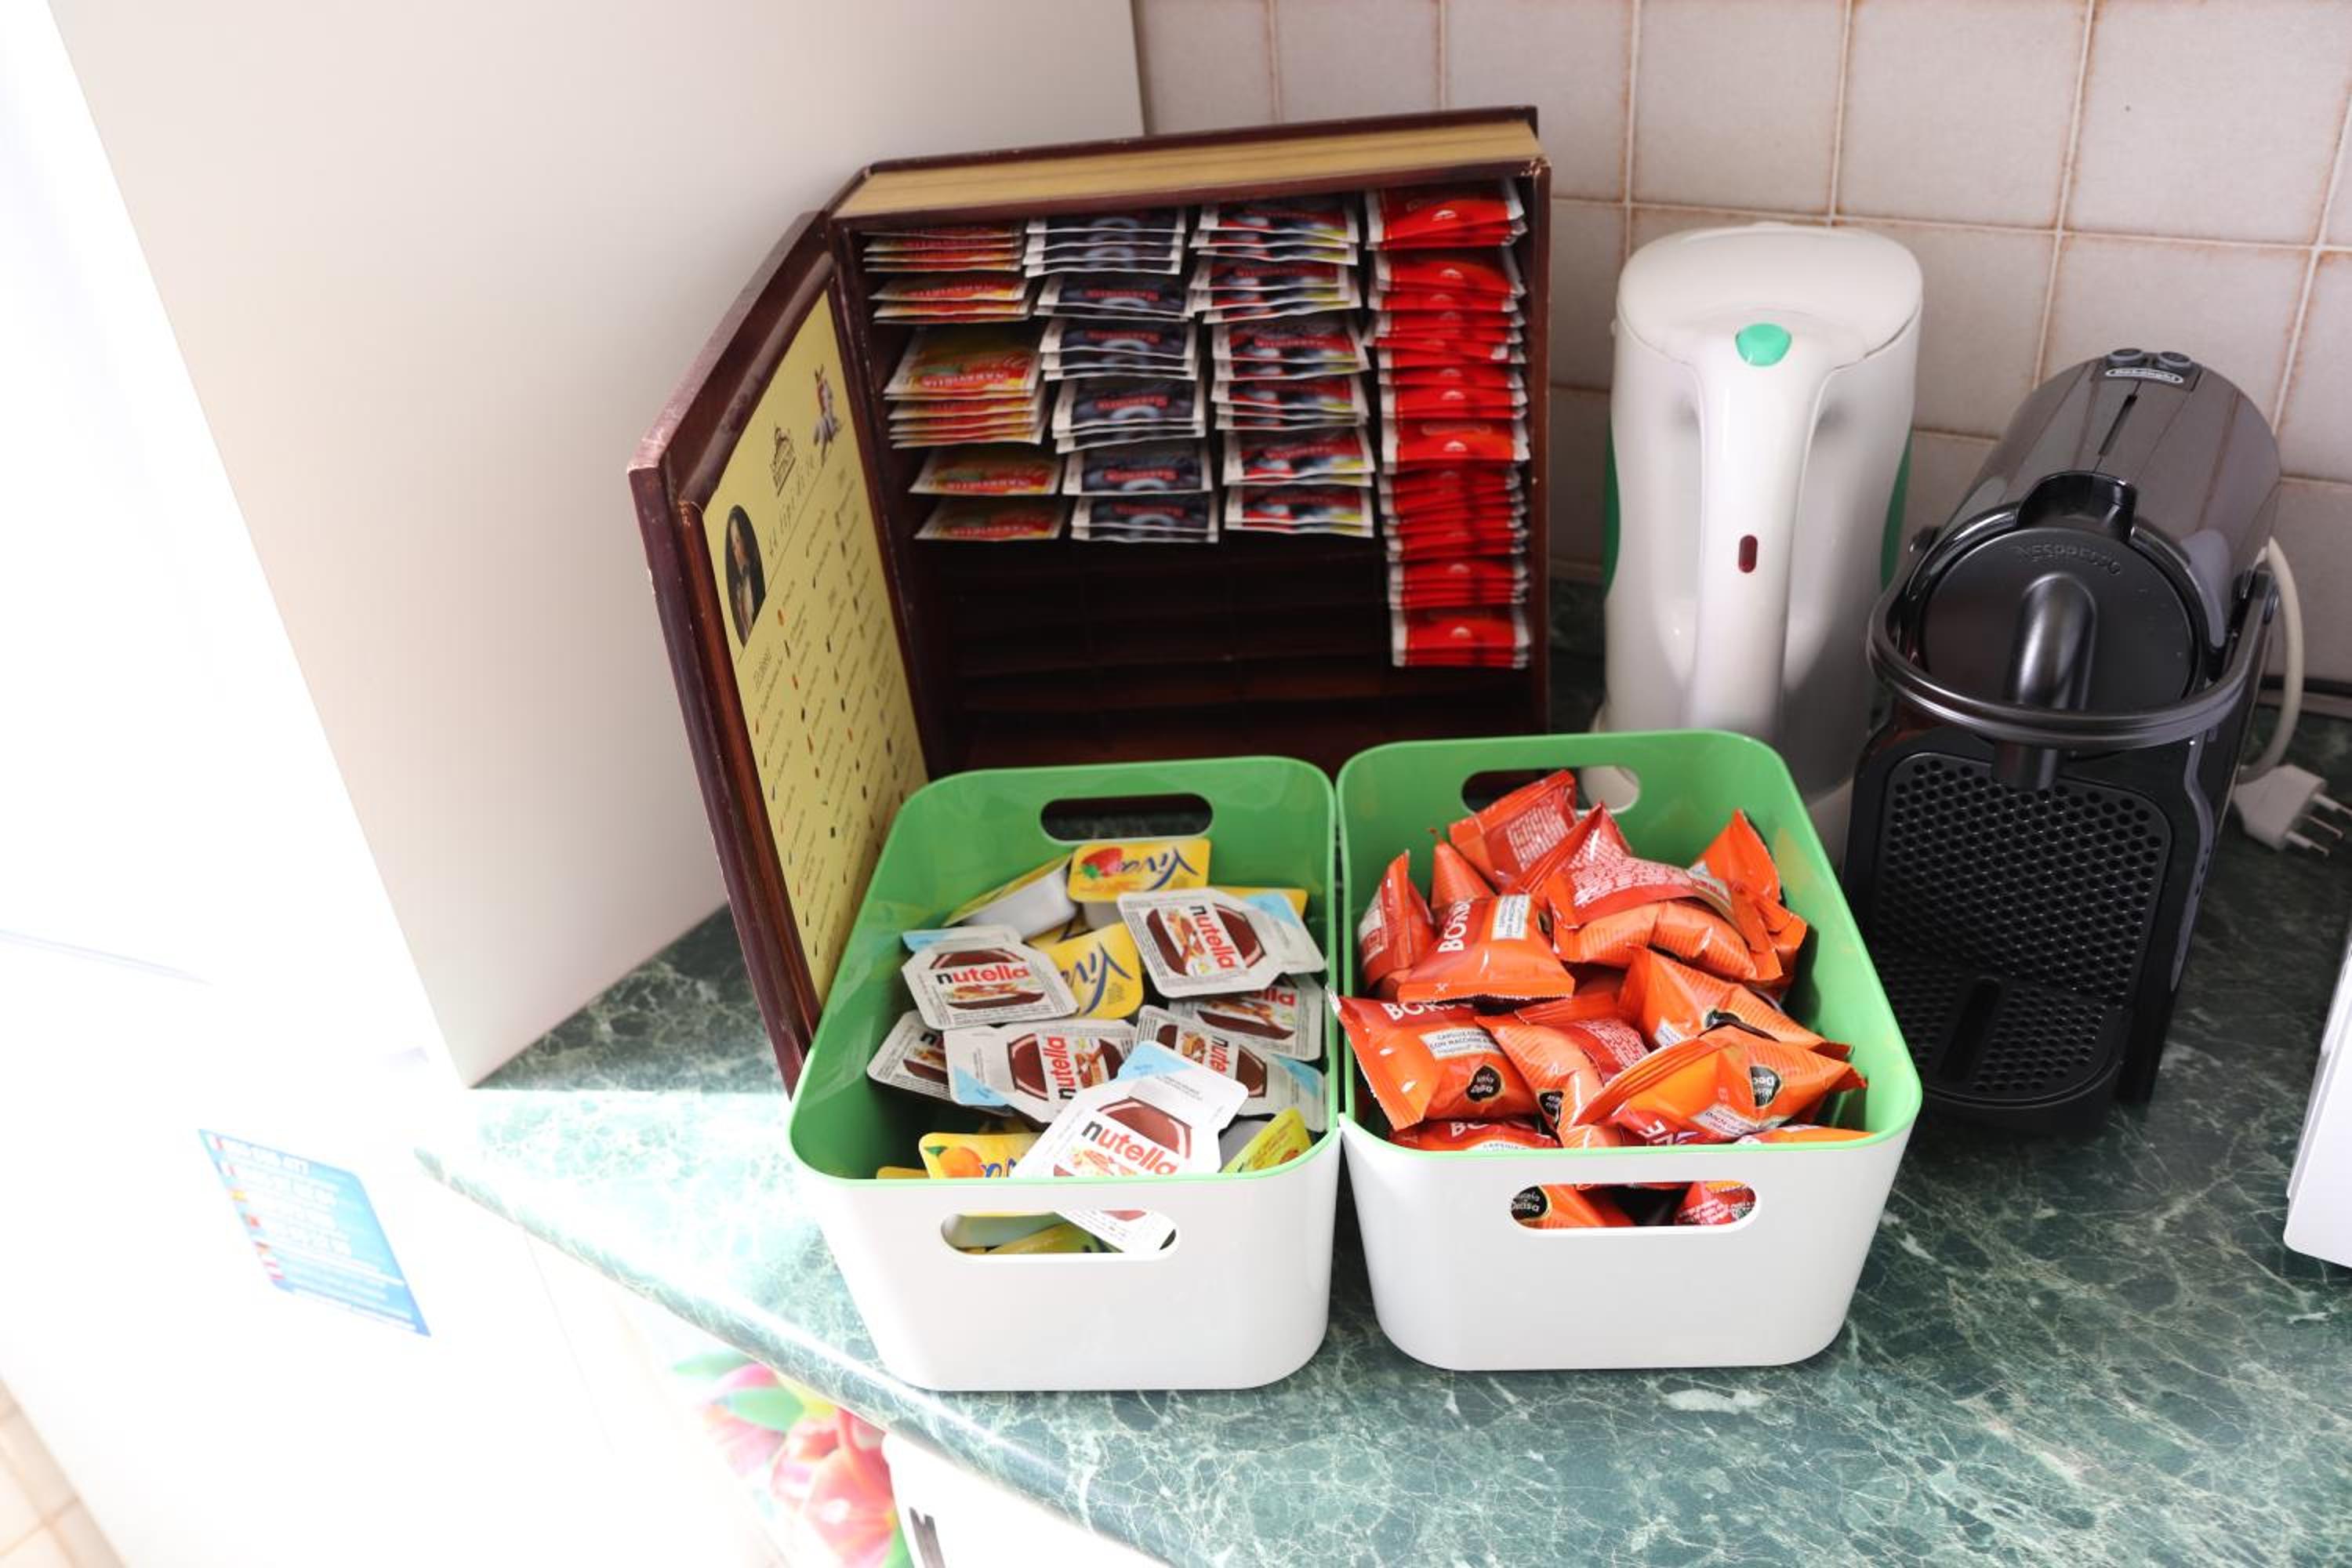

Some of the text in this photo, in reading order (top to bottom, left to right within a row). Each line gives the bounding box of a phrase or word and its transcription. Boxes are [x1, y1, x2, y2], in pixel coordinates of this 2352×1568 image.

[1189, 905, 1237, 969] nutella
[936, 965, 1030, 985] nutella
[1041, 1036, 1077, 1101] nutella
[1210, 1035, 1229, 1074] nute
[1081, 1120, 1178, 1175] nutella
